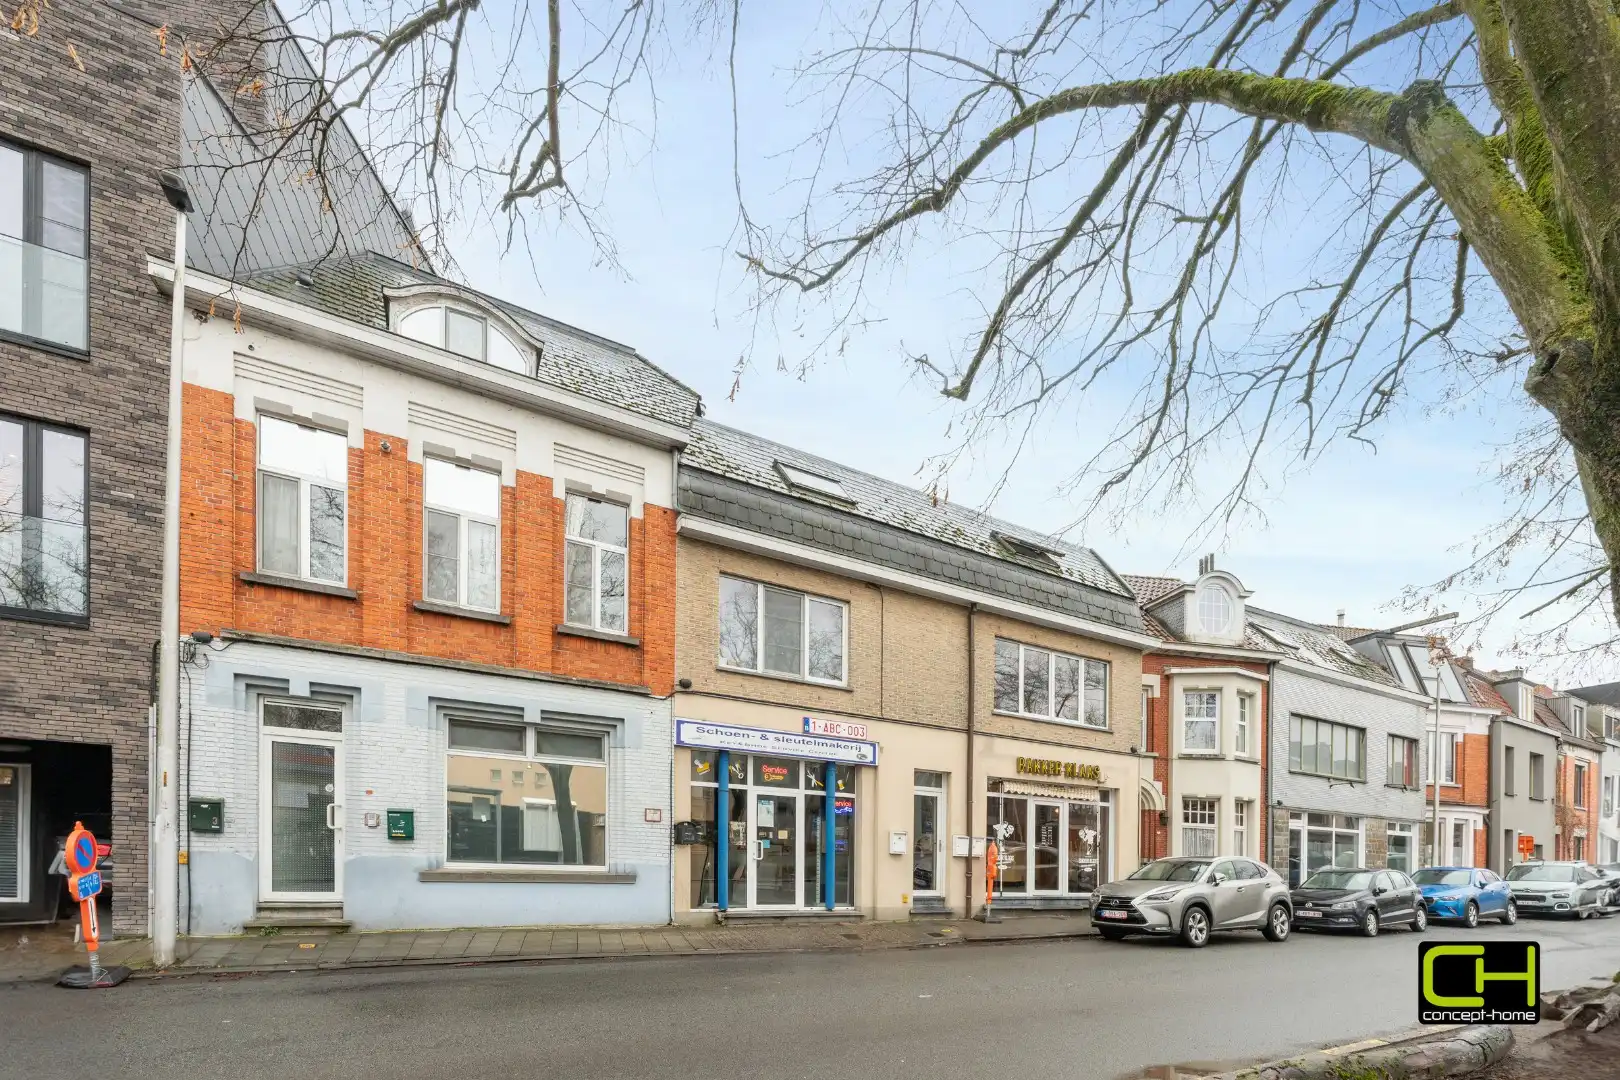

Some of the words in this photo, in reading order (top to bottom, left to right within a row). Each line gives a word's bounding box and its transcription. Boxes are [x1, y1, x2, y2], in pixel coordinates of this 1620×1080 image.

[695, 726, 755, 739] Schoen-
[759, 733, 769, 741] &
[773, 735, 862, 753] sleutelmakerij
[762, 763, 788, 775] Service
[1016, 756, 1062, 776] BAKKER
[1064, 762, 1101, 781] KLAAS
